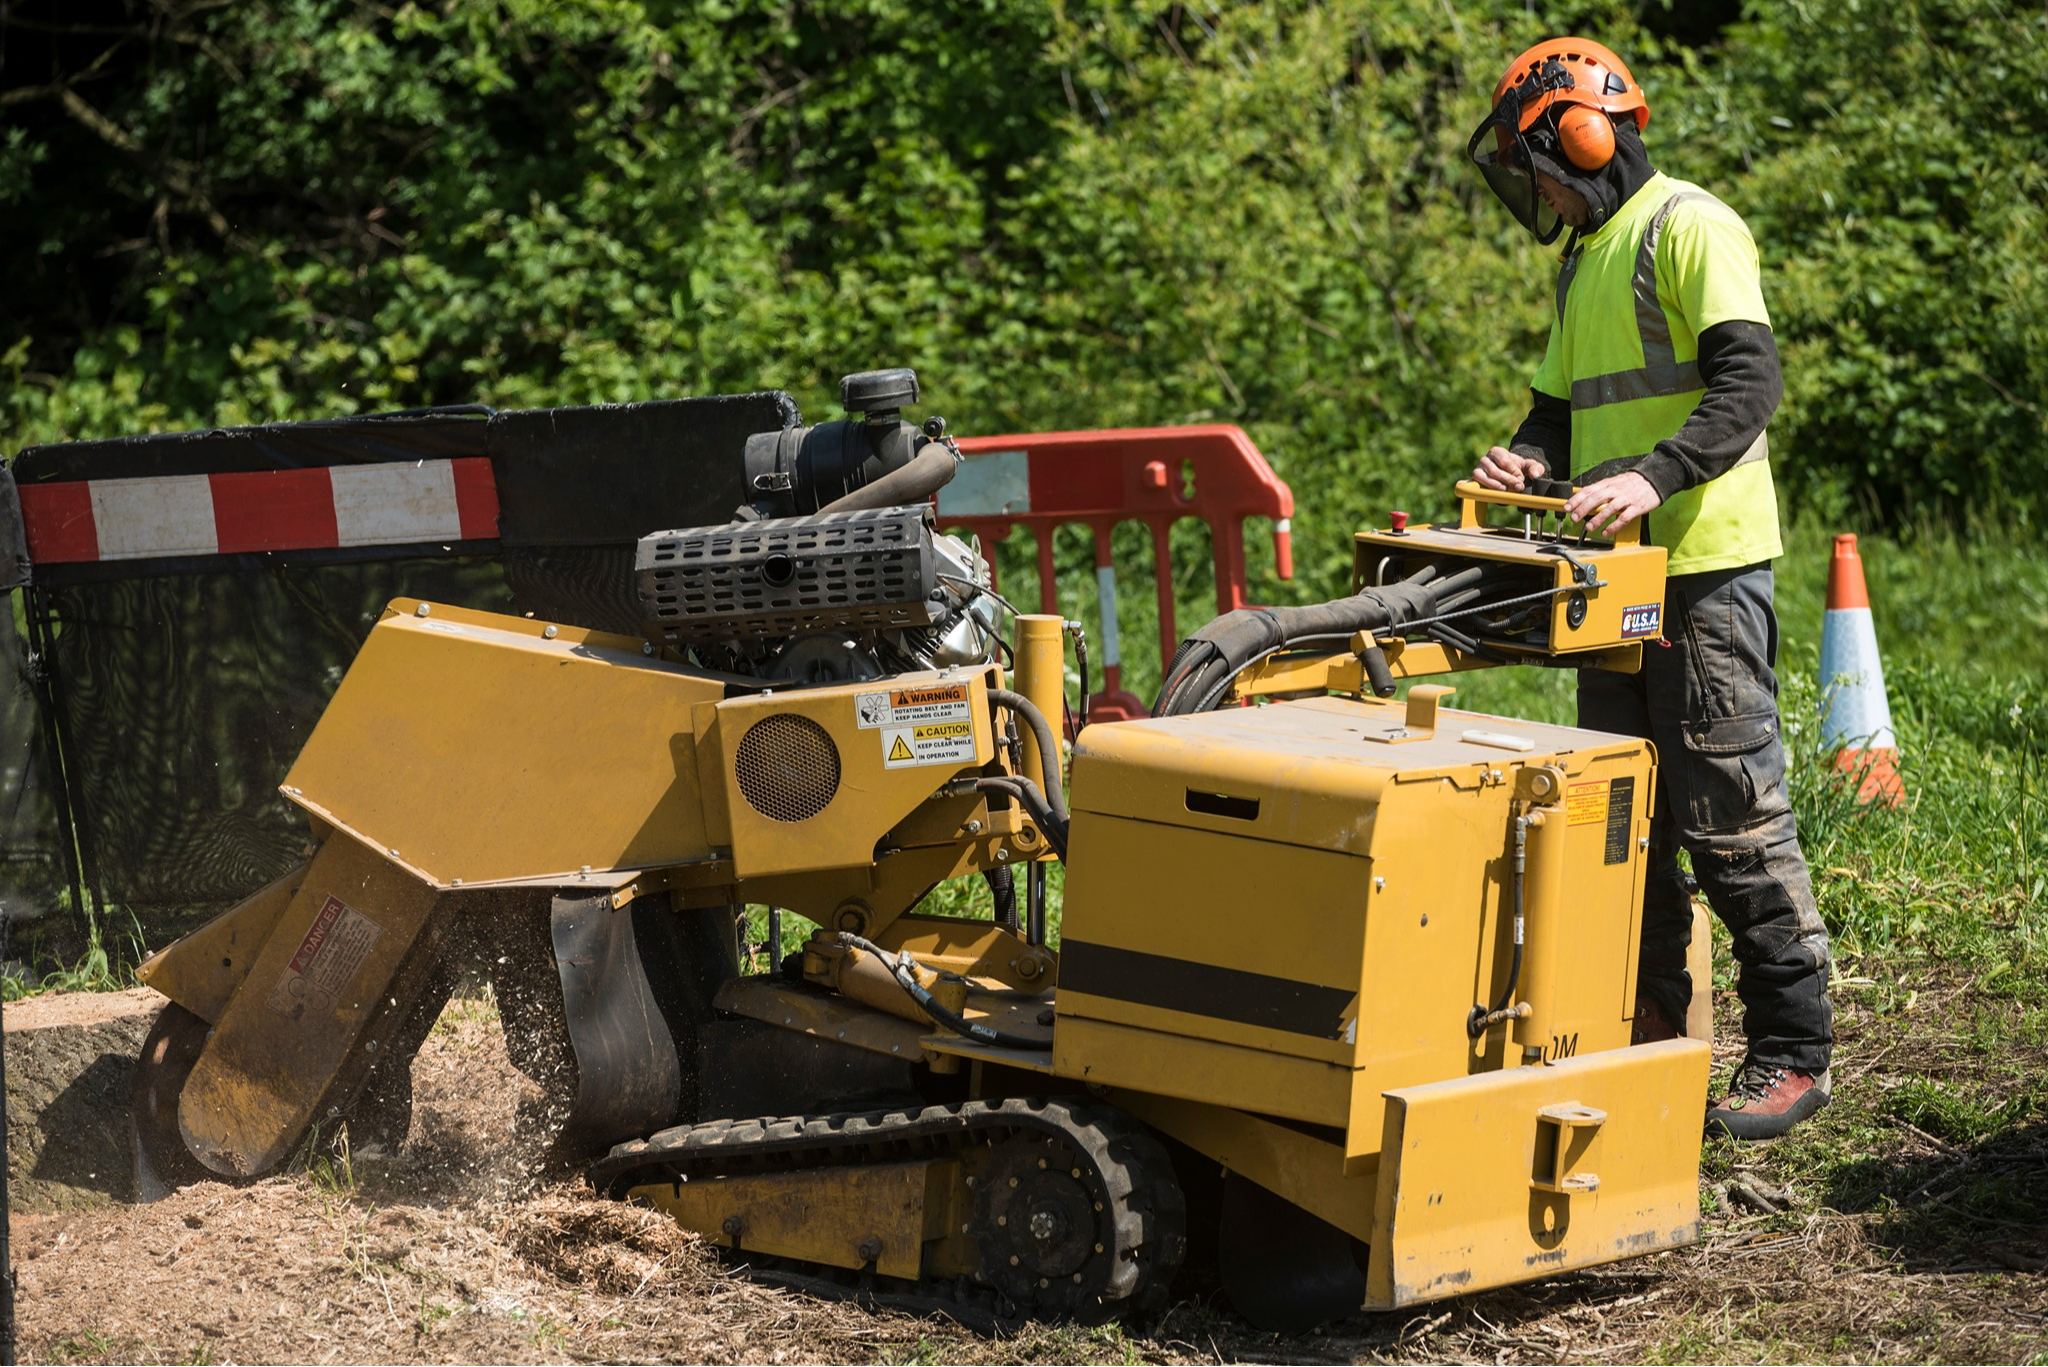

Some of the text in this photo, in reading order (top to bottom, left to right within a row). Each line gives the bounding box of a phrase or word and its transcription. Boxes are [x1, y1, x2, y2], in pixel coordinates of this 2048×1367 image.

[1632, 611, 1659, 628] U.S.A.
[910, 690, 960, 703] WARNING
[894, 706, 923, 715] ROTATING
[926, 724, 969, 737] CAUTION
[917, 738, 972, 750] KEEP CLEAR WHILE
[926, 751, 960, 760] OPERATION
[304, 903, 340, 955] DANGER
